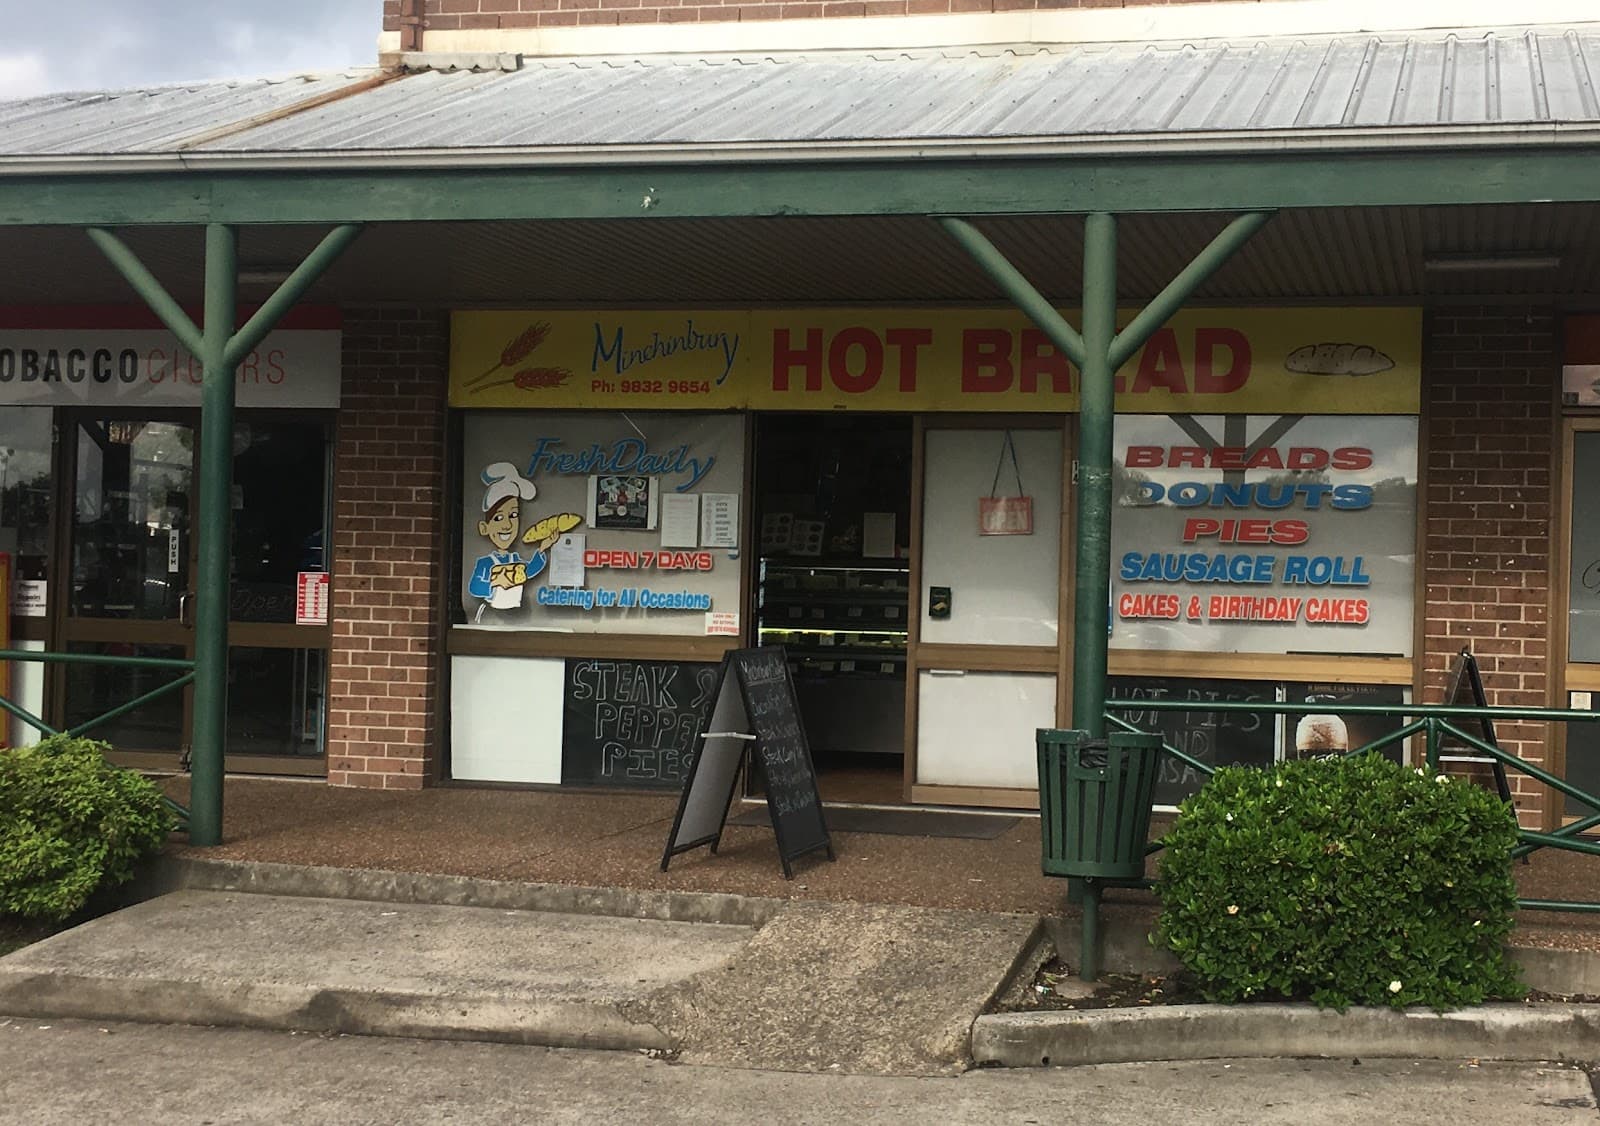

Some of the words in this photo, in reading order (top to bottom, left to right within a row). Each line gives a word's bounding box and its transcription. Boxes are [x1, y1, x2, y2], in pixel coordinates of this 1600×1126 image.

[149, 349, 286, 384] CIGRS
[592, 320, 739, 386] Minchinbury
[772, 327, 932, 393] HOT
[961, 327, 1252, 393] BRAD
[592, 380, 615, 393] Ph:
[621, 380, 663, 394] 9832
[668, 381, 710, 394] 9654
[527, 438, 606, 476] Fresh
[605, 438, 715, 491] Daily
[1124, 446, 1374, 471] BREADS
[1136, 482, 1374, 509] DONUTS
[1182, 518, 1310, 544] PIES
[583, 549, 638, 568] OPEN
[641, 550, 655, 569] 7
[656, 550, 713, 570] DAYS
[1119, 551, 1276, 584] SAUSAGE
[1282, 555, 1371, 585] ROLL
[536, 586, 594, 609] Catering
[597, 587, 617, 606] for
[618, 588, 637, 608] All
[639, 588, 712, 609] Occasions
[1118, 593, 1180, 618] CAKES
[1187, 595, 1202, 619] &
[1207, 595, 1302, 622] BIRTHDAY
[1304, 597, 1370, 624] CAKES
[573, 662, 678, 709] STEAK
